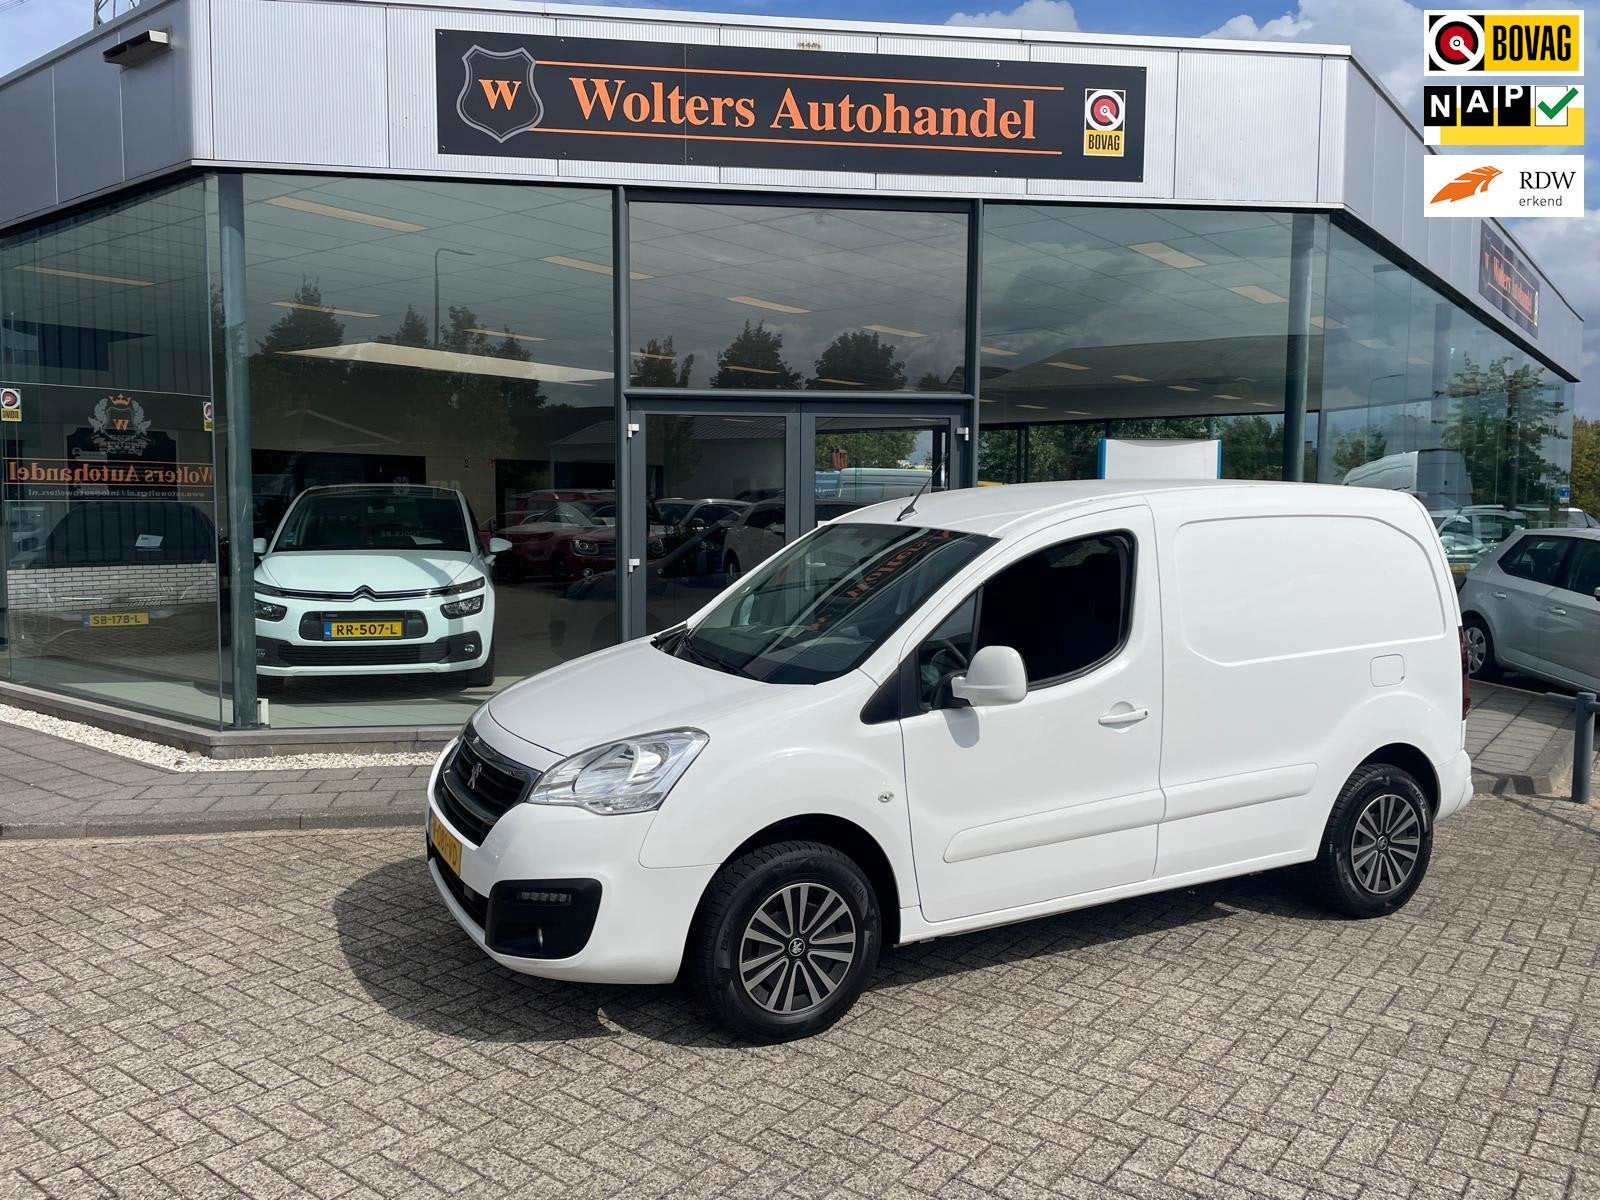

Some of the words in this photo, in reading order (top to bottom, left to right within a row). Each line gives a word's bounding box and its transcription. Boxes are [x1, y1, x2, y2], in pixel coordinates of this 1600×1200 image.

[478, 79, 522, 111] W
[568, 77, 755, 128] Wolters
[770, 87, 1036, 140] Autohandel
[1088, 134, 1120, 151] BOVAG
[93, 615, 141, 625] SB-178-L
[336, 623, 398, 636] RR-507-L
